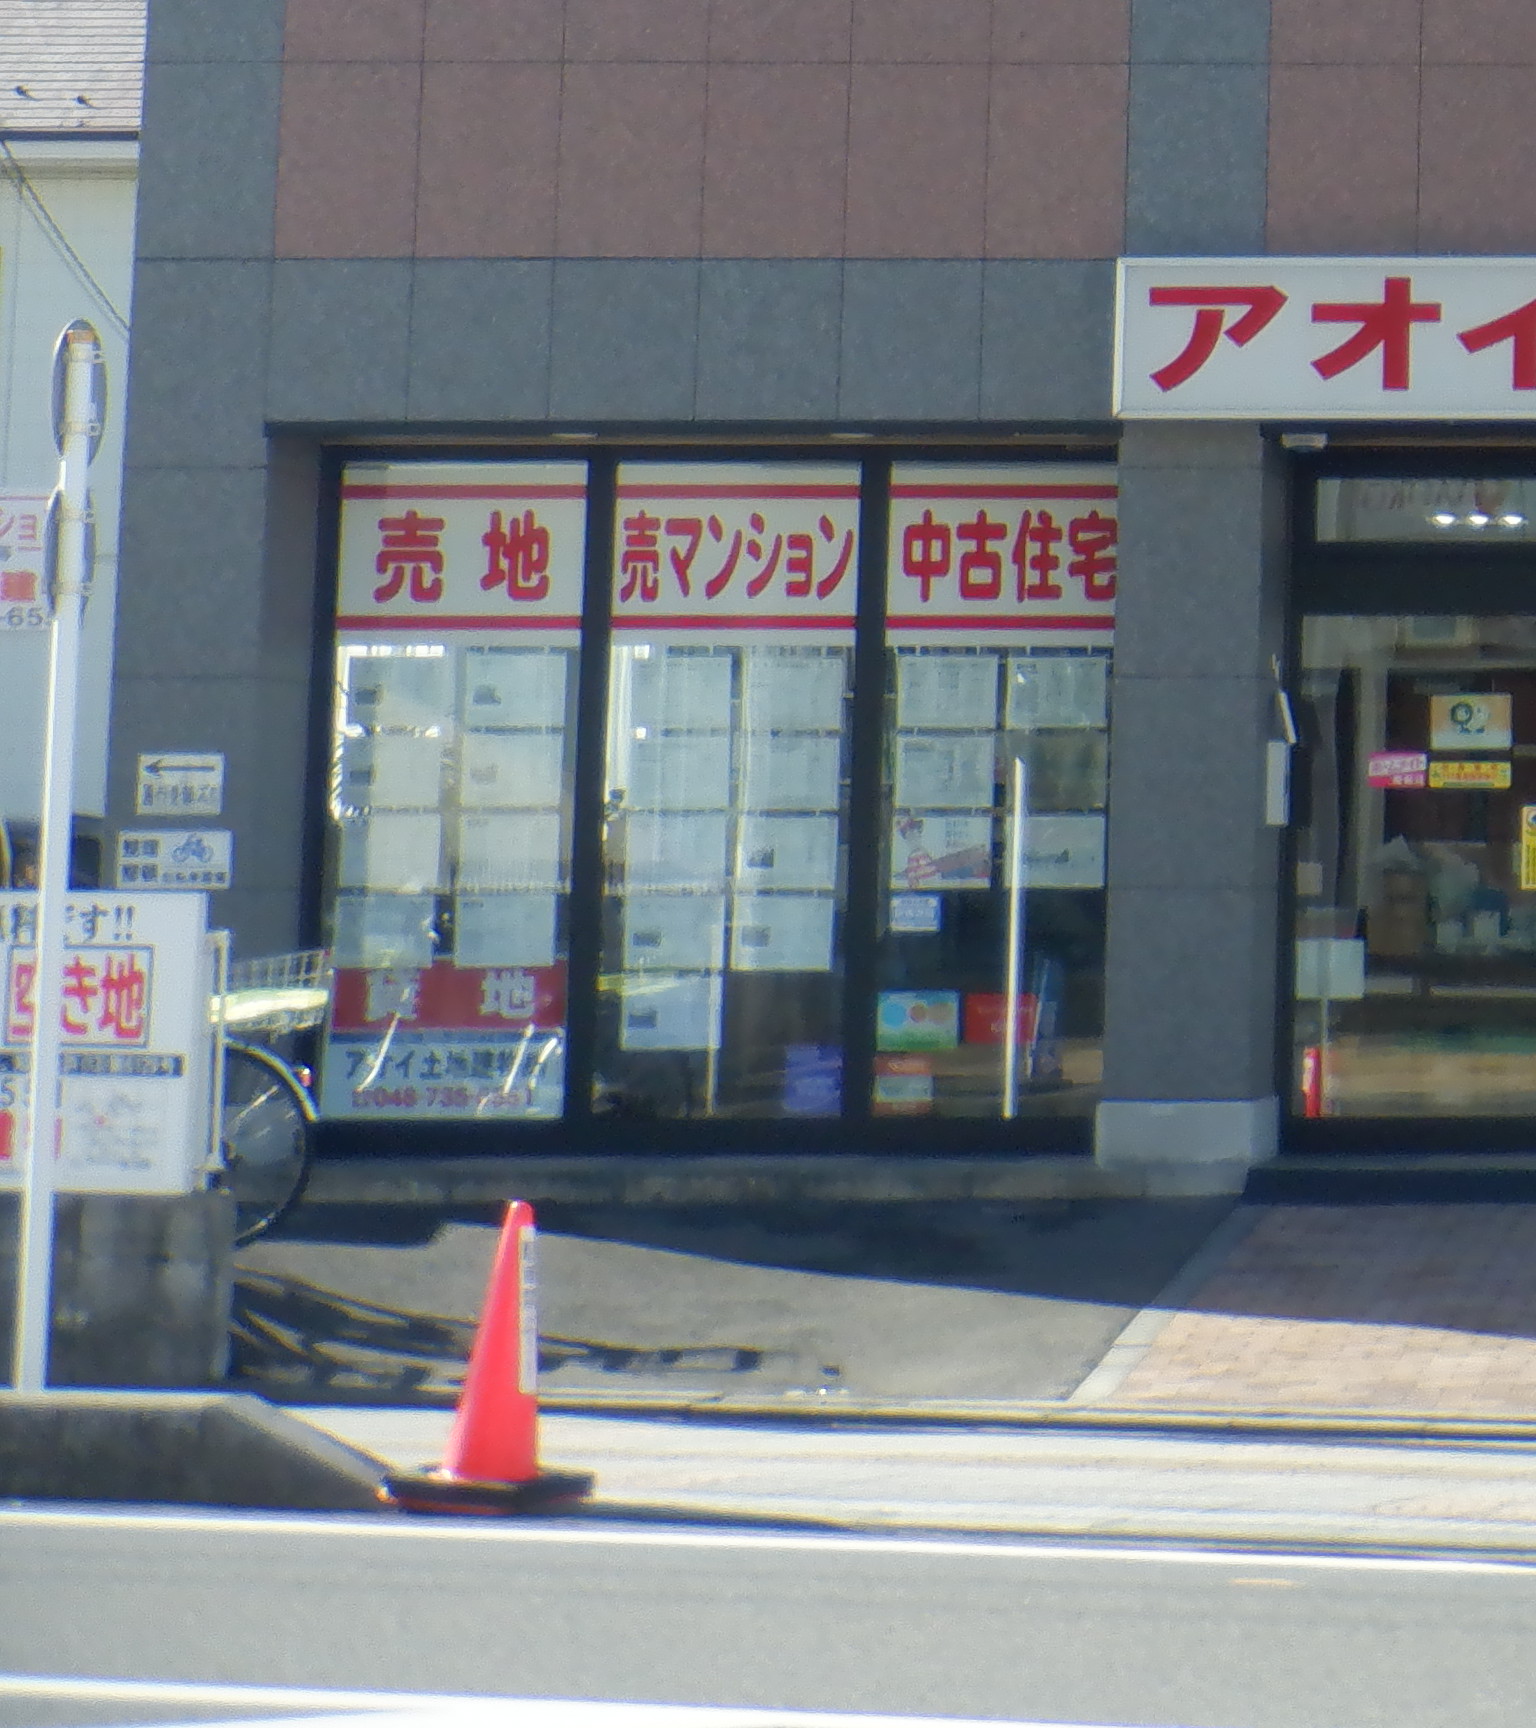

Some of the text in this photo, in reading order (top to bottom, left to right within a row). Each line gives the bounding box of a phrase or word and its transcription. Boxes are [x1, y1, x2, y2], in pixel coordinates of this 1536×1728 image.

[373, 509, 551, 604] 売地
[619, 509, 855, 603] 売マンション
[902, 508, 1117, 604] 中古住宅
